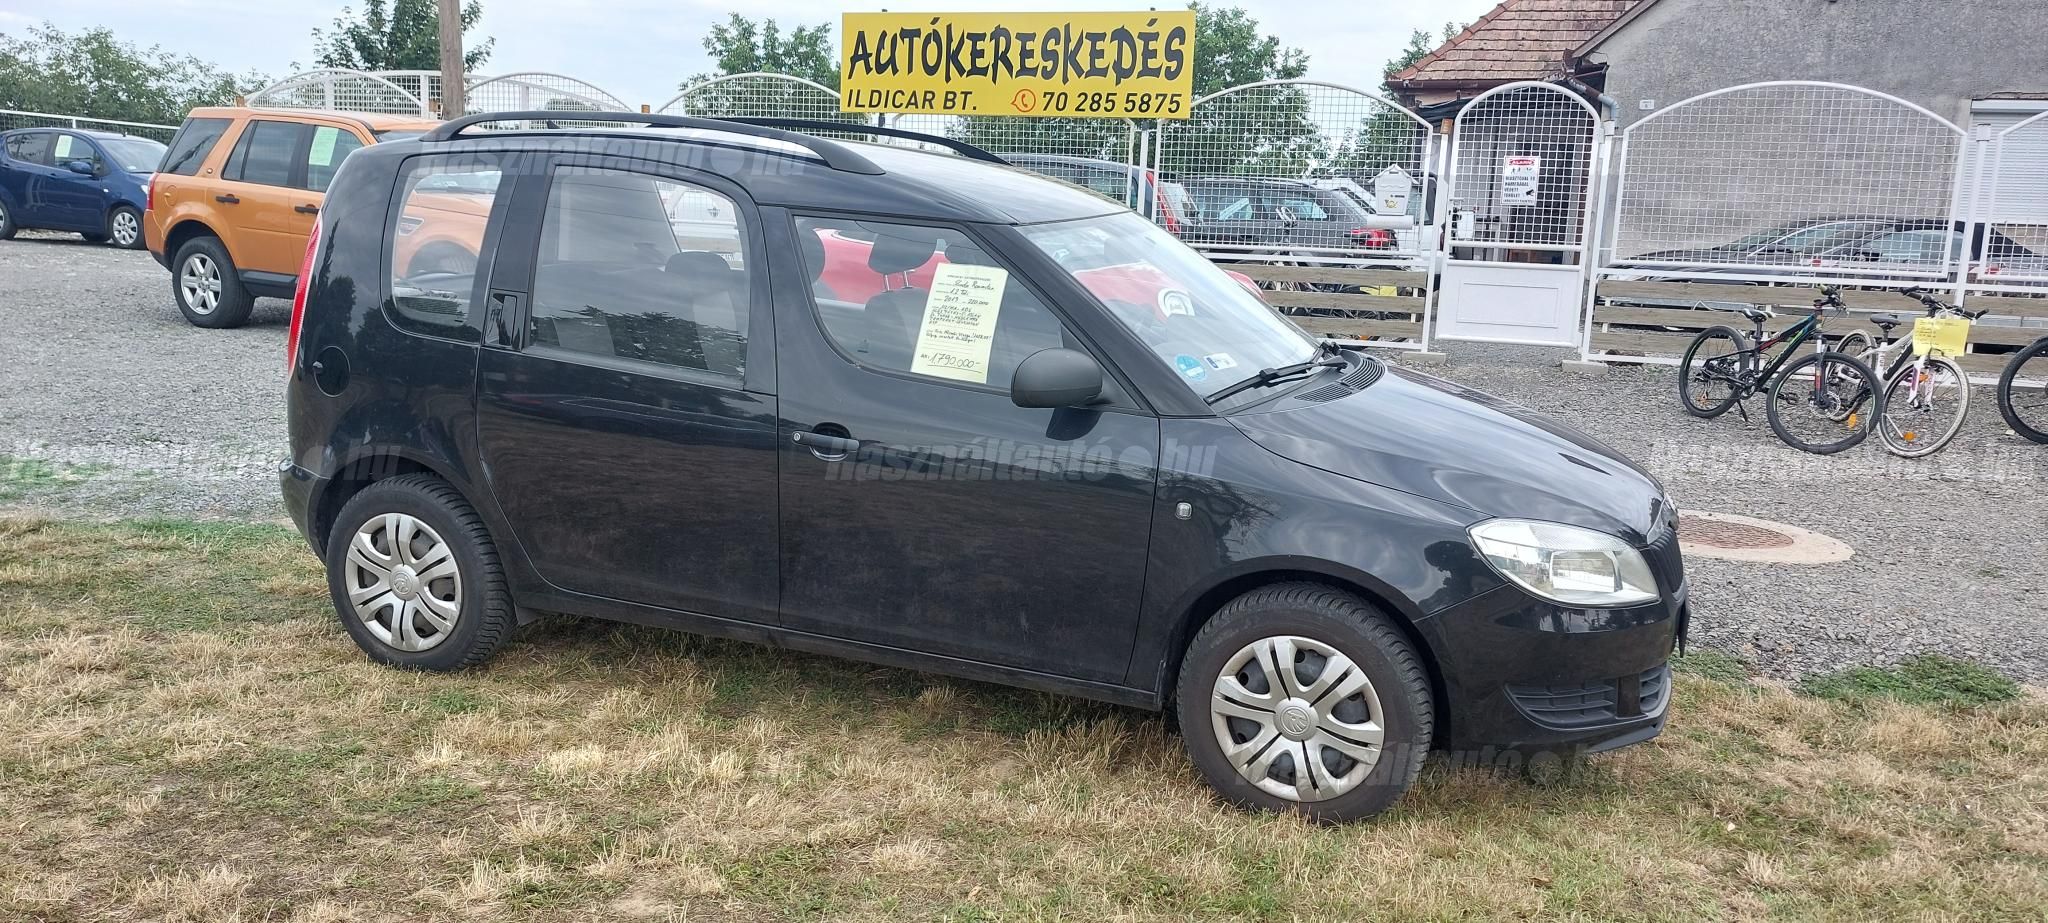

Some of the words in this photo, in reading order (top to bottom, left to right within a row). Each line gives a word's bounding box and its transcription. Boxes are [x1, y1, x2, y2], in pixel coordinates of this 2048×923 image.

[848, 17, 1187, 86] AUTÓKERESKEDÉS
[847, 88, 936, 109] ILDICAR
[944, 90, 978, 111] BT.
[1042, 91, 1068, 112] 70
[1075, 92, 1118, 113] 285
[1124, 93, 1182, 114] 5875
